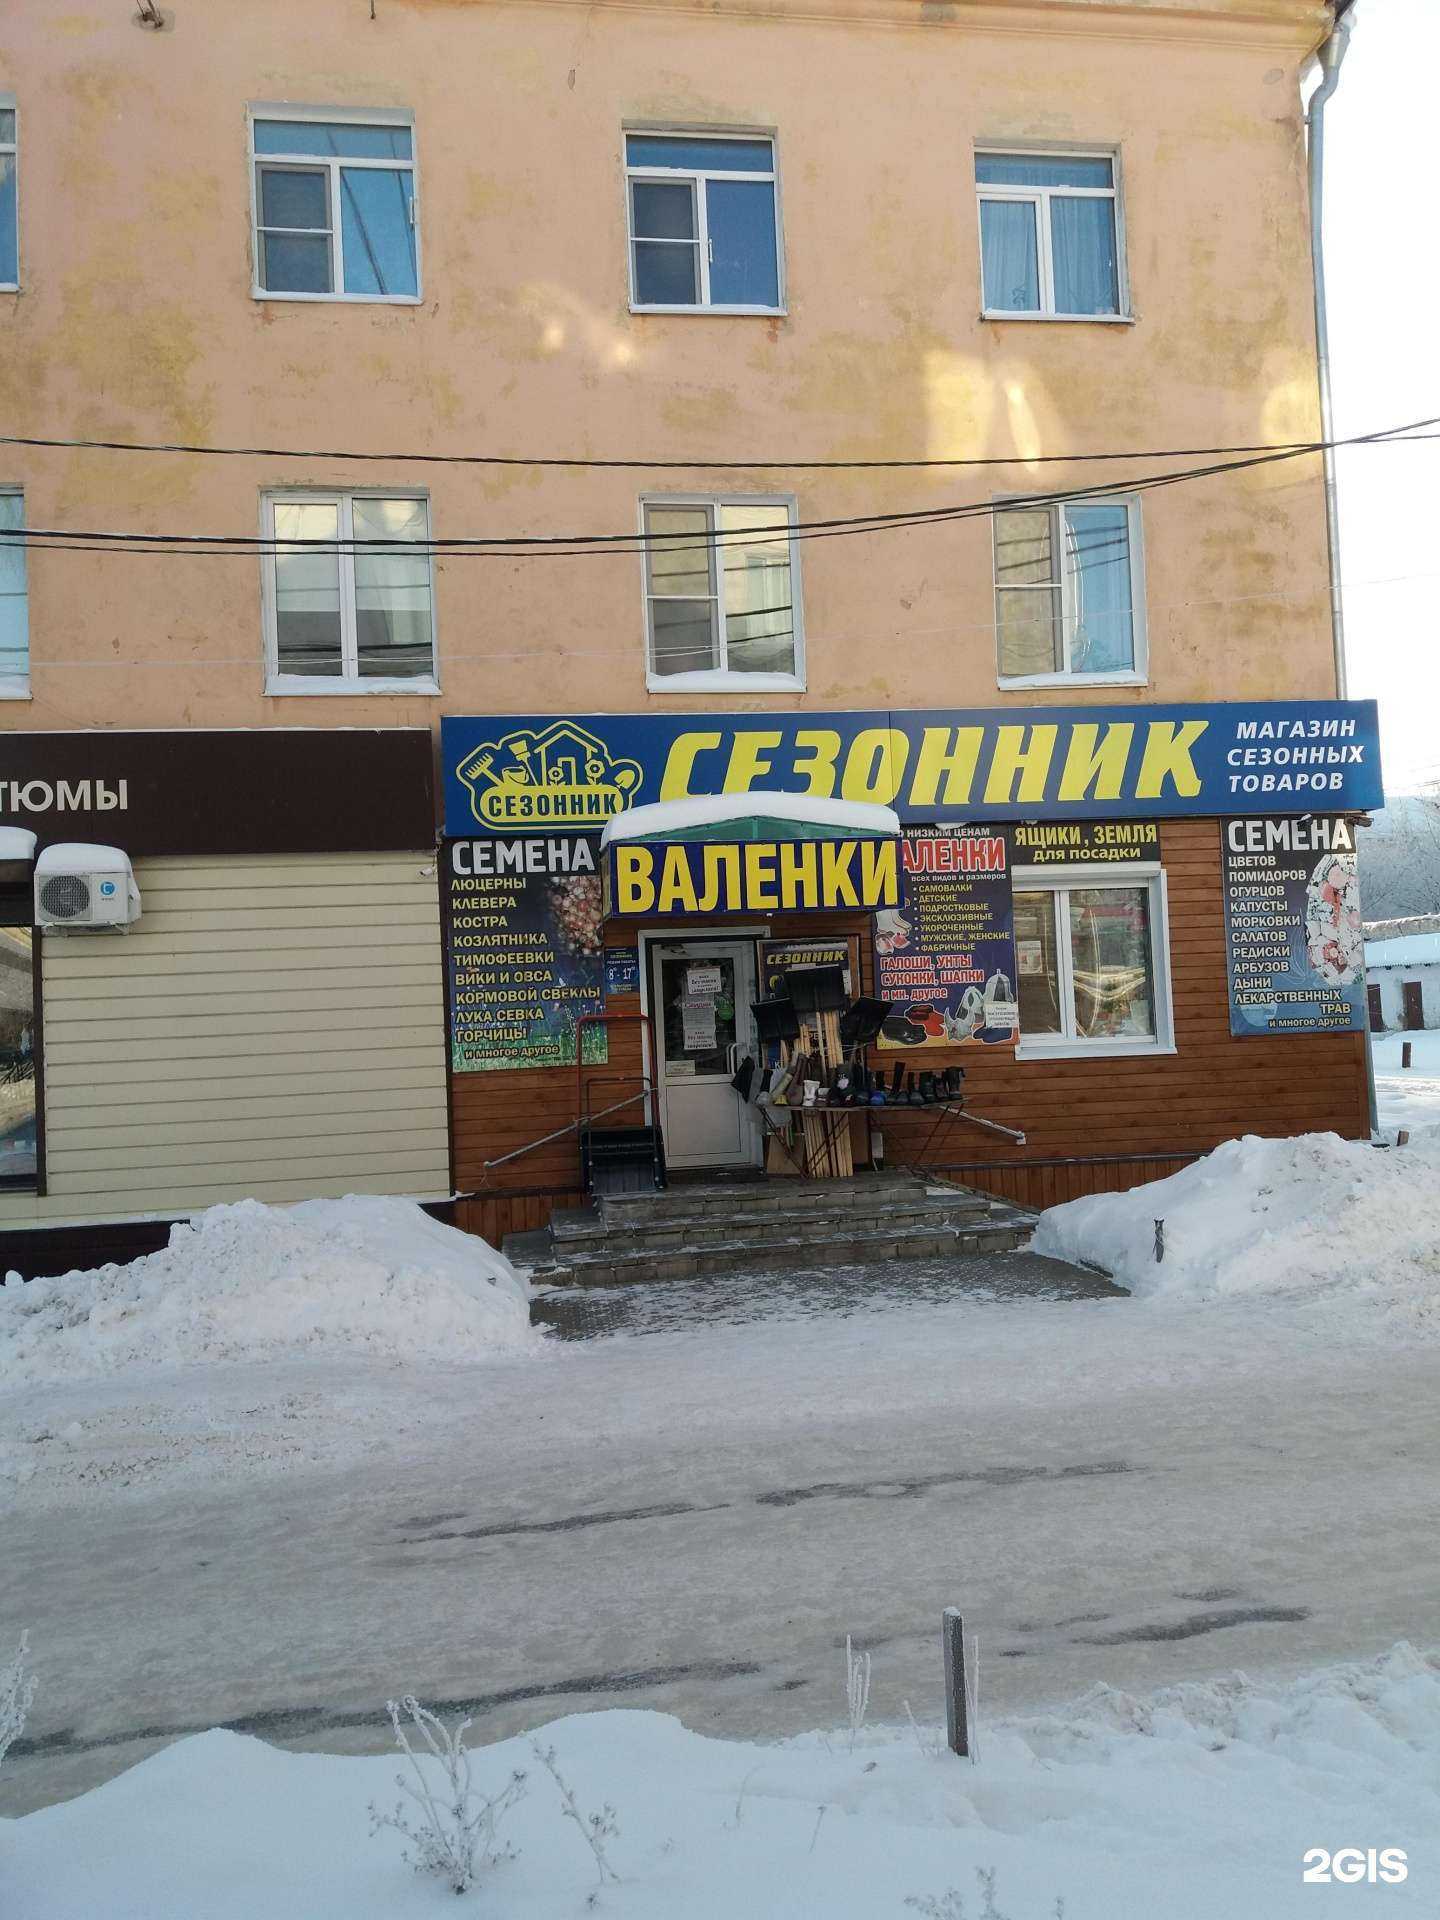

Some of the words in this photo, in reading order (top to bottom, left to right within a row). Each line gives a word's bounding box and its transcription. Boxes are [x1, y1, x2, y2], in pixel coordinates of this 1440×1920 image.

[1236, 720, 1356, 740] МАГАЗИН
[1227, 745, 1365, 766] СЕЗОННЫХ
[659, 721, 1209, 806] СЕЗОННИК
[1228, 772, 1343, 793] ТОВАРОВ
[488, 793, 617, 817] СЕЗОННИК
[907, 828, 951, 838] НИЗКИМ
[954, 827, 990, 838] ЦЕНАМ
[1094, 824, 1157, 844] ЗЕМЛЯ
[1228, 819, 1353, 852] СЕМЕНА
[452, 838, 596, 875] СЕМЕНА
[902, 837, 1006, 873] АЛЕНКИ
[1033, 848, 1065, 862] для
[1069, 847, 1141, 861] посадки
[1228, 855, 1276, 868] ЦВЕТОВ
[616, 840, 899, 913] ВАЛЕНКИ
[911, 874, 930, 882] всех
[932, 874, 957, 882] видов
[966, 873, 1007, 882] размеров
[1229, 870, 1307, 882] ПОМИДОРОВ
[451, 877, 526, 892] ЛЮЦЕРНЫ
[919, 883, 973, 893] САМОВАЛКИ
[1229, 885, 1285, 898] ОГУРЦОВ
[452, 896, 517, 910] КЛЕВЕРА
[919, 893, 957, 903] ДЕТСКИЕ
[920, 903, 989, 912] ПОДРОСТКОВЫЕ
[1230, 900, 1288, 913] КАПУСТЫ
[453, 915, 508, 929] КОСТРА
[920, 912, 993, 922] ЭКСКЛЮЗИВНЫЕ
[1231, 915, 1300, 928] МОРКОВКИ
[920, 922, 984, 931] УКОРОЧЕННЫЕ
[453, 932, 548, 947] КОЗЛЯТНИКА
[968, 931, 1010, 940] ЖЕНСКИЕ
[1231, 931, 1287, 943] САЛАТОВ
[921, 942, 976, 951] ФАБРИЧНЫЕ
[1232, 946, 1290, 959] РЕДИСКИ
[454, 951, 554, 966] ТИМОФЕЕВКИ
[767, 950, 846, 965] СЕЗОННИК
[880, 956, 935, 970] ГАЛОШИ,
[937, 954, 972, 968] УНТЫ
[1233, 961, 1290, 974] АРБУЗОВ
[455, 972, 496, 986] ВИКИ
[500, 972, 510, 983] И
[513, 970, 553, 982] ОВСА
[881, 972, 938, 986] СУКОНКИ,
[941, 970, 984, 983] ШАПКИ
[1233, 977, 1271, 990] ДЫНИ
[456, 987, 537, 1004] КОРМОВОЙ
[541, 986, 600, 1000] СВЕКЛЫ
[882, 990, 889, 1000] и
[891, 988, 909, 999] мн.
[910, 988, 947, 1001] другое
[1235, 989, 1341, 1004] ЛЕКАРСТВЕННЫХ
[456, 1010, 492, 1023] ЛУКА
[496, 1008, 544, 1021] СЕВКА
[1320, 1003, 1351, 1014] ТРАВ
[1278, 1018, 1316, 1028] многое
[1317, 1016, 1351, 1027] другое
[457, 1027, 527, 1043] ГОРЧИЦЫ
[465, 1051, 472, 1059] и
[476, 1047, 518, 1059] многое
[521, 1045, 560, 1057] другое
